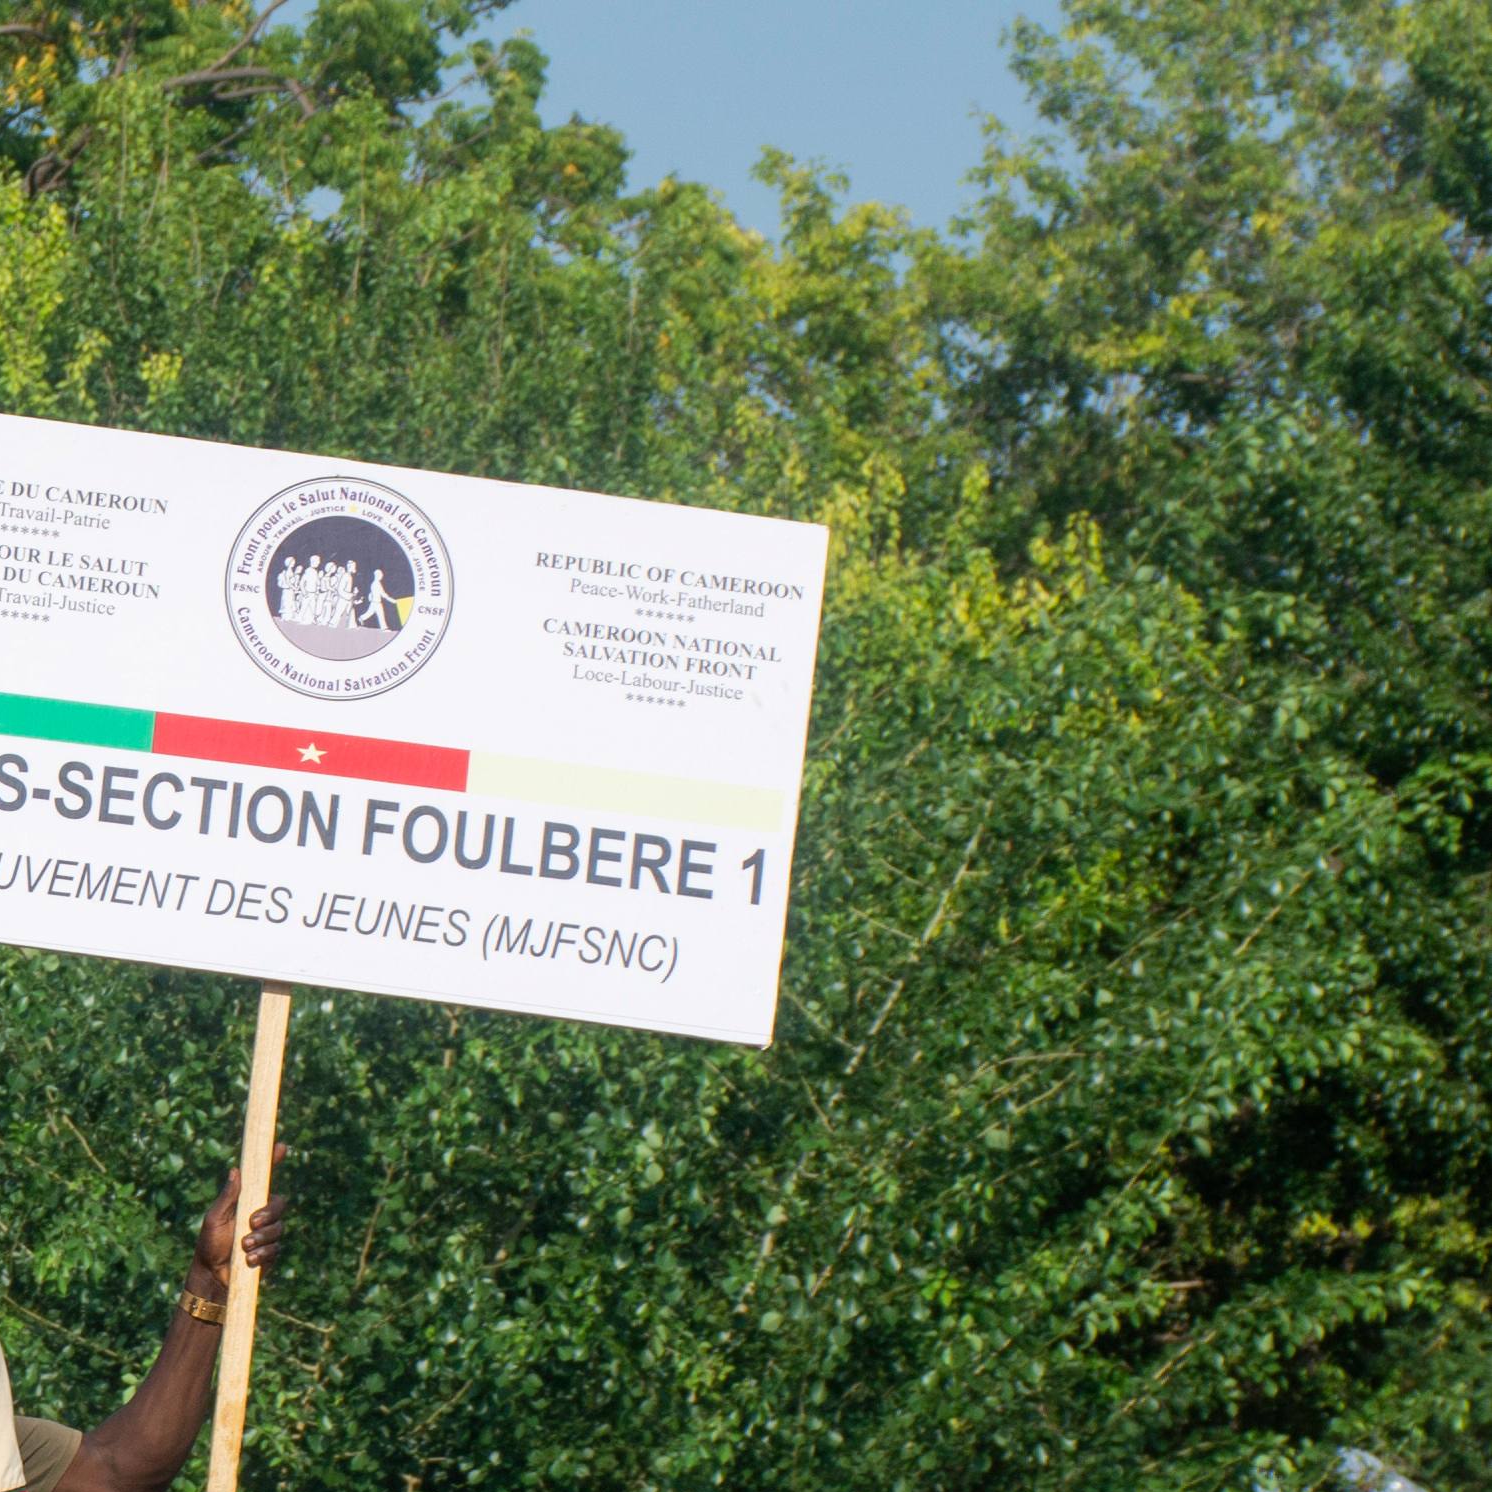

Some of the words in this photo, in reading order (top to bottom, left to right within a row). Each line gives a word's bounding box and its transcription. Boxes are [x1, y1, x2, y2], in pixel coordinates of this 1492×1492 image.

[10, 481, 40, 500] DU
[45, 486, 169, 514] CAMEROUN
[310, 505, 346, 518] JUSTICE
[236, 537, 260, 576] Front
[257, 511, 283, 541] pour
[283, 500, 296, 514] le
[298, 489, 336, 507] Salut
[339, 487, 397, 517] National
[398, 511, 416, 529] du
[414, 527, 442, 597] Cameroun
[3, 567, 32, 584] DU
[38, 570, 160, 599] CAMEROUN
[48, 551, 74, 568] LE
[79, 554, 149, 577] SALUT
[536, 552, 643, 580] REPUBLIC
[647, 566, 677, 584] OF
[680, 570, 805, 600] CAMEROON
[232, 582, 261, 594] FSNC
[569, 577, 766, 618] Peace-Work-Fatherland
[417, 605, 446, 617] CNSF
[237, 606, 280, 669] Cameroon
[280, 662, 341, 692] National
[344, 661, 408, 692] Salvation
[404, 628, 437, 663] Front
[543, 617, 668, 647] CAMEROON
[672, 633, 782, 663] NATIONAL
[562, 641, 680, 671] SALVATION
[684, 656, 758, 681] FRONT
[572, 664, 745, 701] Loce-Labour-Justice
[361, 798, 716, 902] FOULBERE
[740, 847, 767, 907] 1
[205, 879, 294, 928] DES
[302, 888, 473, 949] JEUNES
[481, 909, 681, 984] (MJFSNC)
